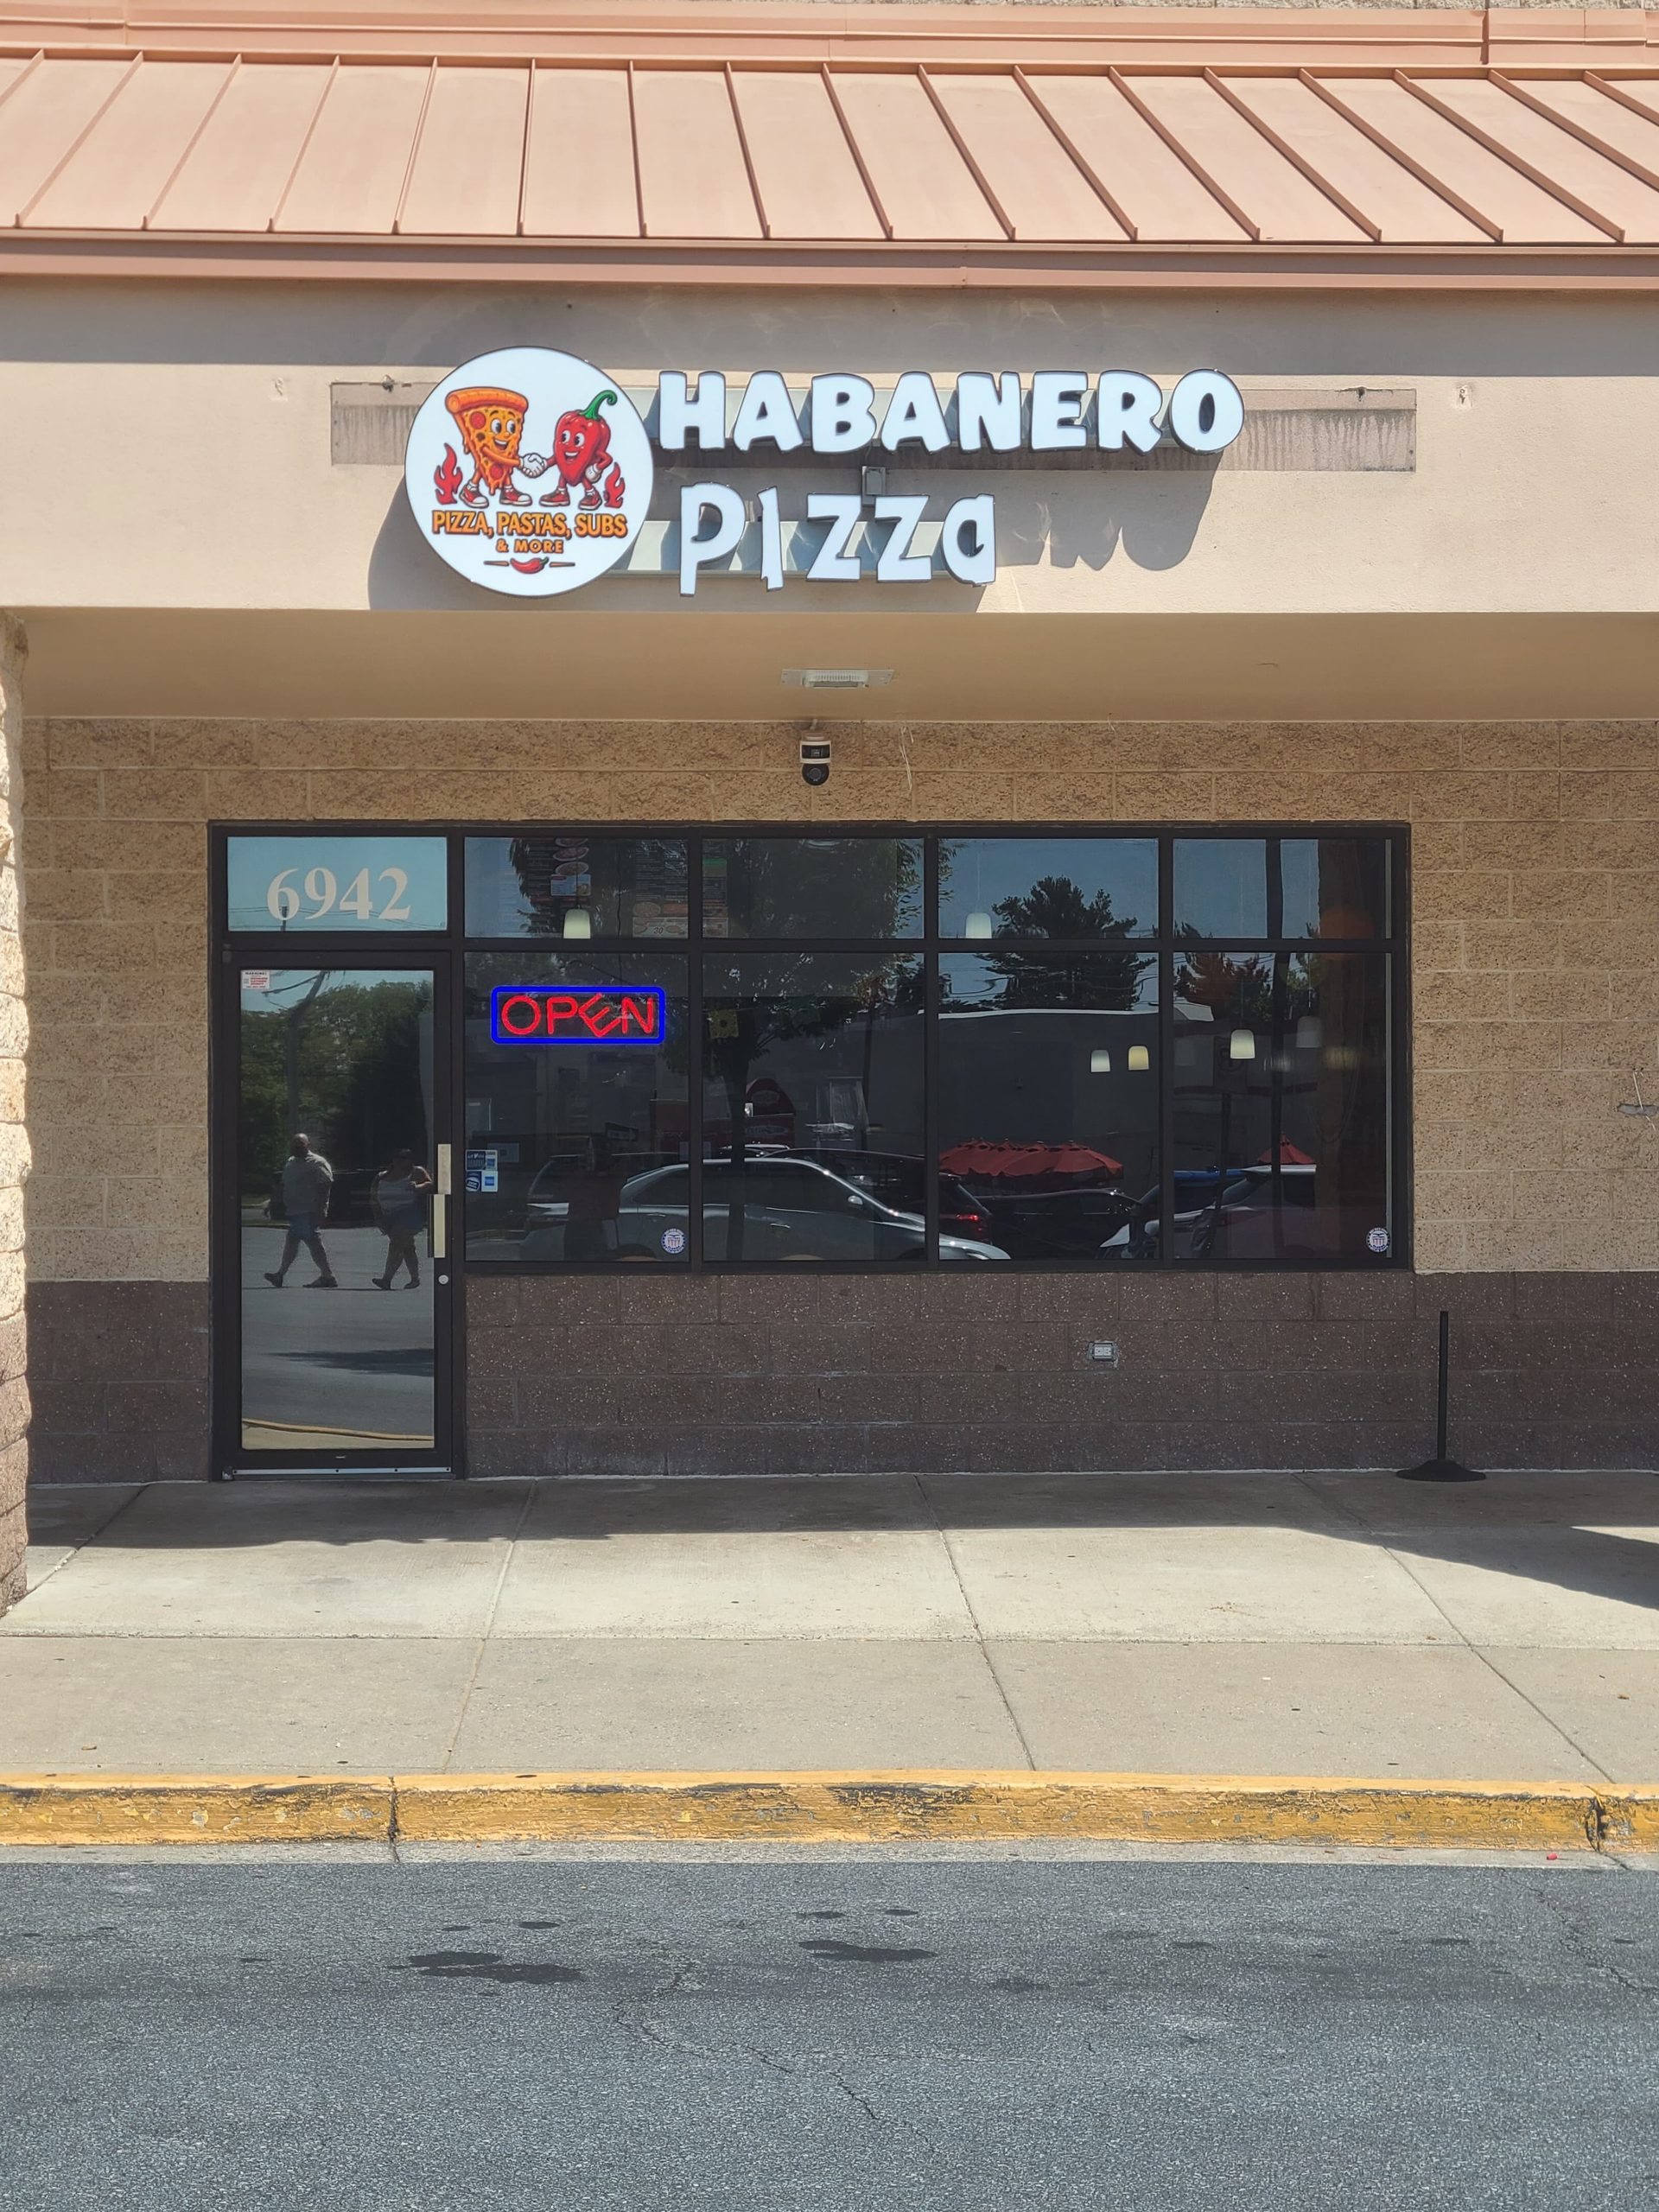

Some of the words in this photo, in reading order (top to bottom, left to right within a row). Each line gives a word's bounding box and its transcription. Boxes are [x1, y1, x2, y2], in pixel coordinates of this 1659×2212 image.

[658, 369, 1244, 455] HABANERO
[432, 510, 493, 537] PIZZA,
[496, 512, 572, 540] PASTAS,
[575, 513, 628, 537] SUBS
[495, 538, 509, 553] &
[514, 538, 564, 554] MORE
[267, 867, 411, 921] 6942
[501, 993, 654, 1038] OPEN
